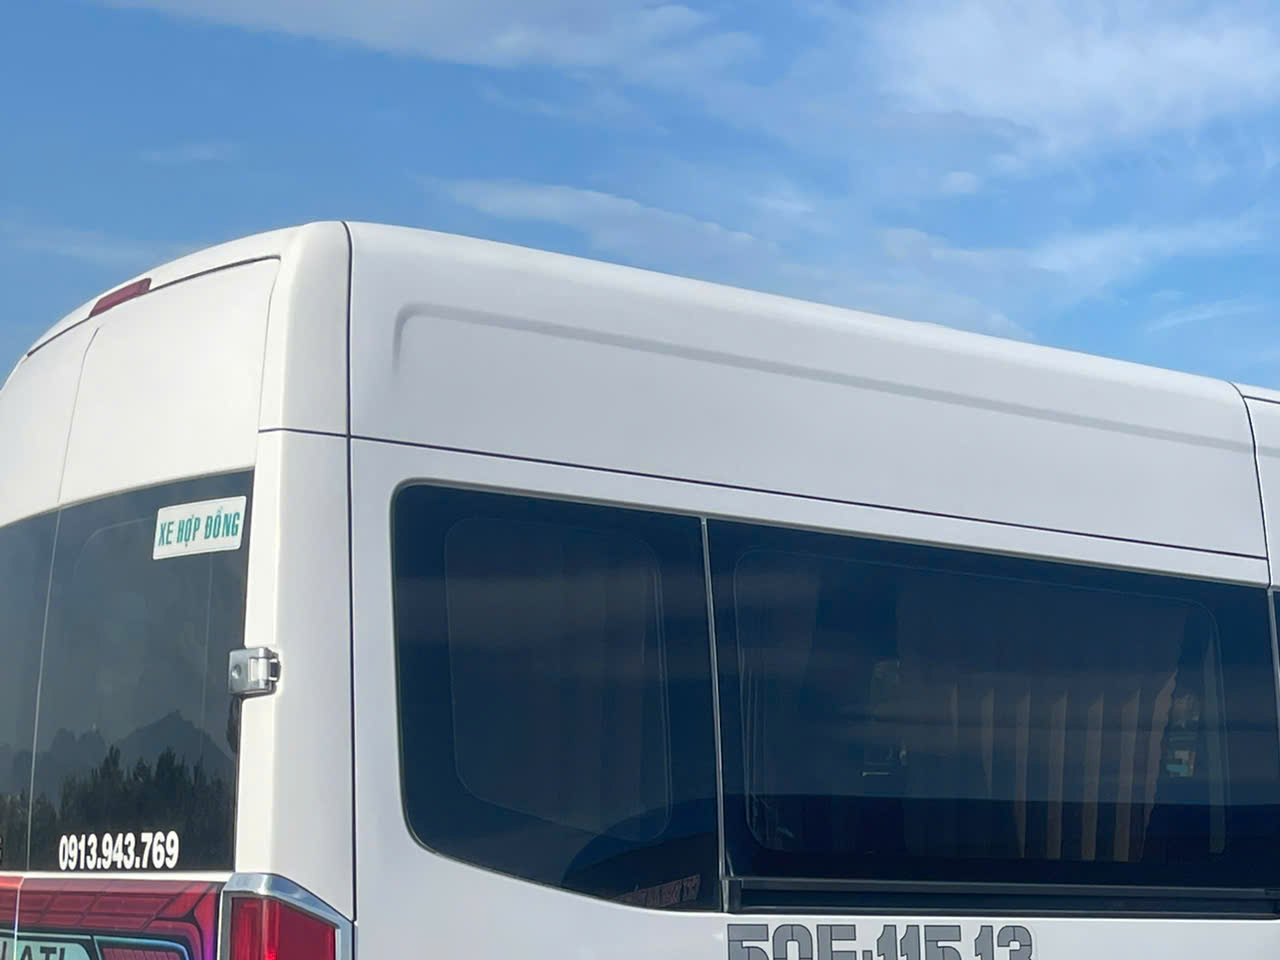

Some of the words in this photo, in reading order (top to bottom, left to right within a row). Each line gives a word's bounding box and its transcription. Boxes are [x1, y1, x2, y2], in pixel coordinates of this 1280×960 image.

[158, 521, 174, 546] XE
[177, 514, 201, 547] HỢP
[204, 506, 240, 540] ĐỒNG
[58, 831, 180, 871] 0913.943.769
